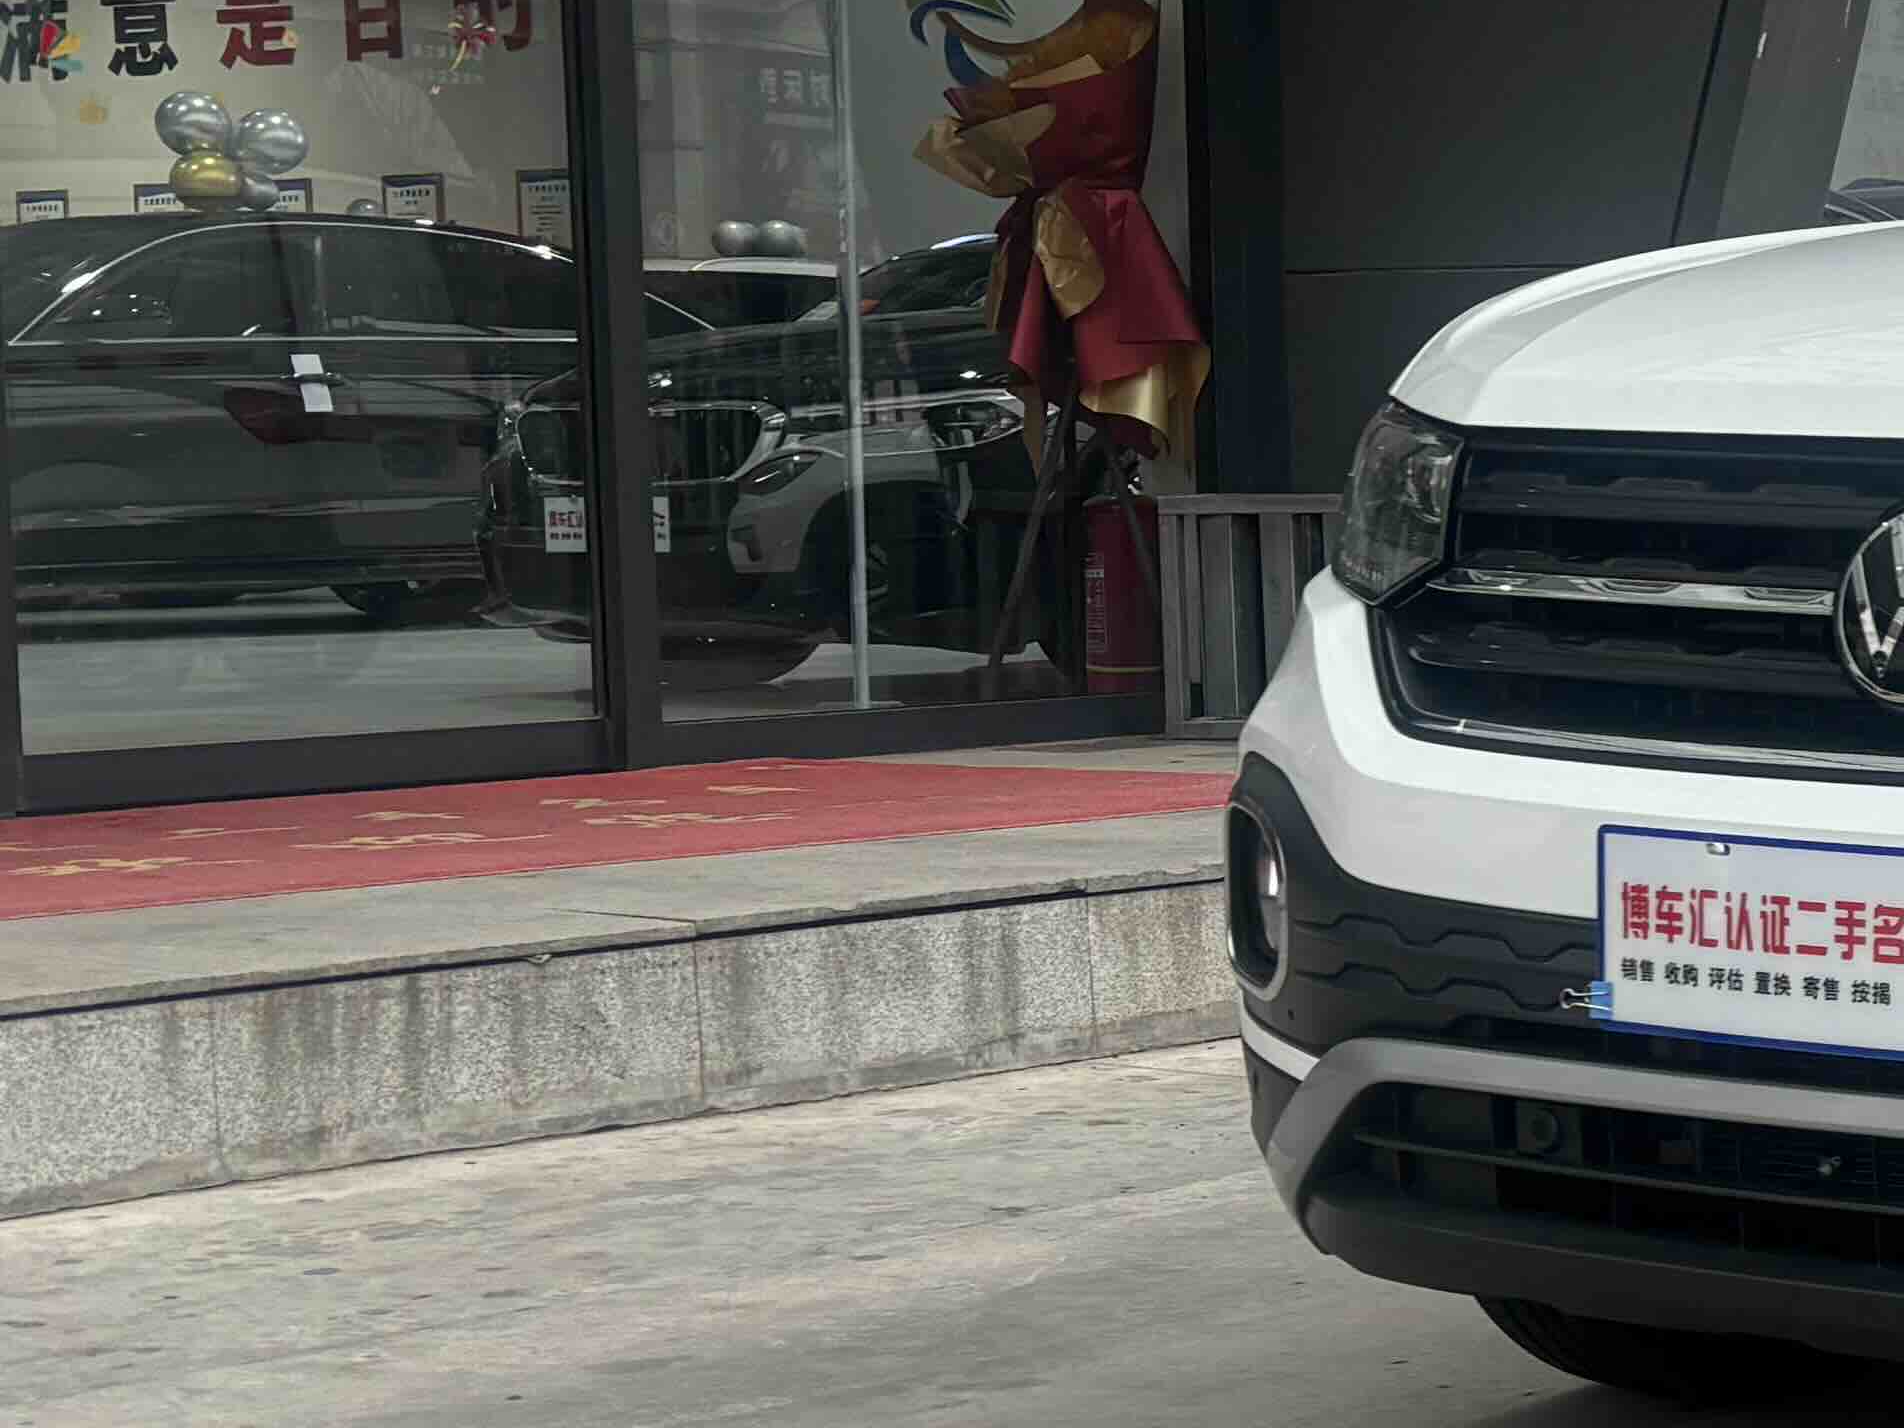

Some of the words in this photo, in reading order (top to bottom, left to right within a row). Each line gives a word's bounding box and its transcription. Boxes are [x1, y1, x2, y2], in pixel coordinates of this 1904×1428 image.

[1621, 958, 1655, 982] 销售
[1664, 962, 1699, 988] 收购
[1708, 967, 1744, 993] 评估
[1754, 972, 1792, 997] 置换
[1803, 976, 1840, 1002] 寄售
[1851, 980, 1891, 1006] 按揭
